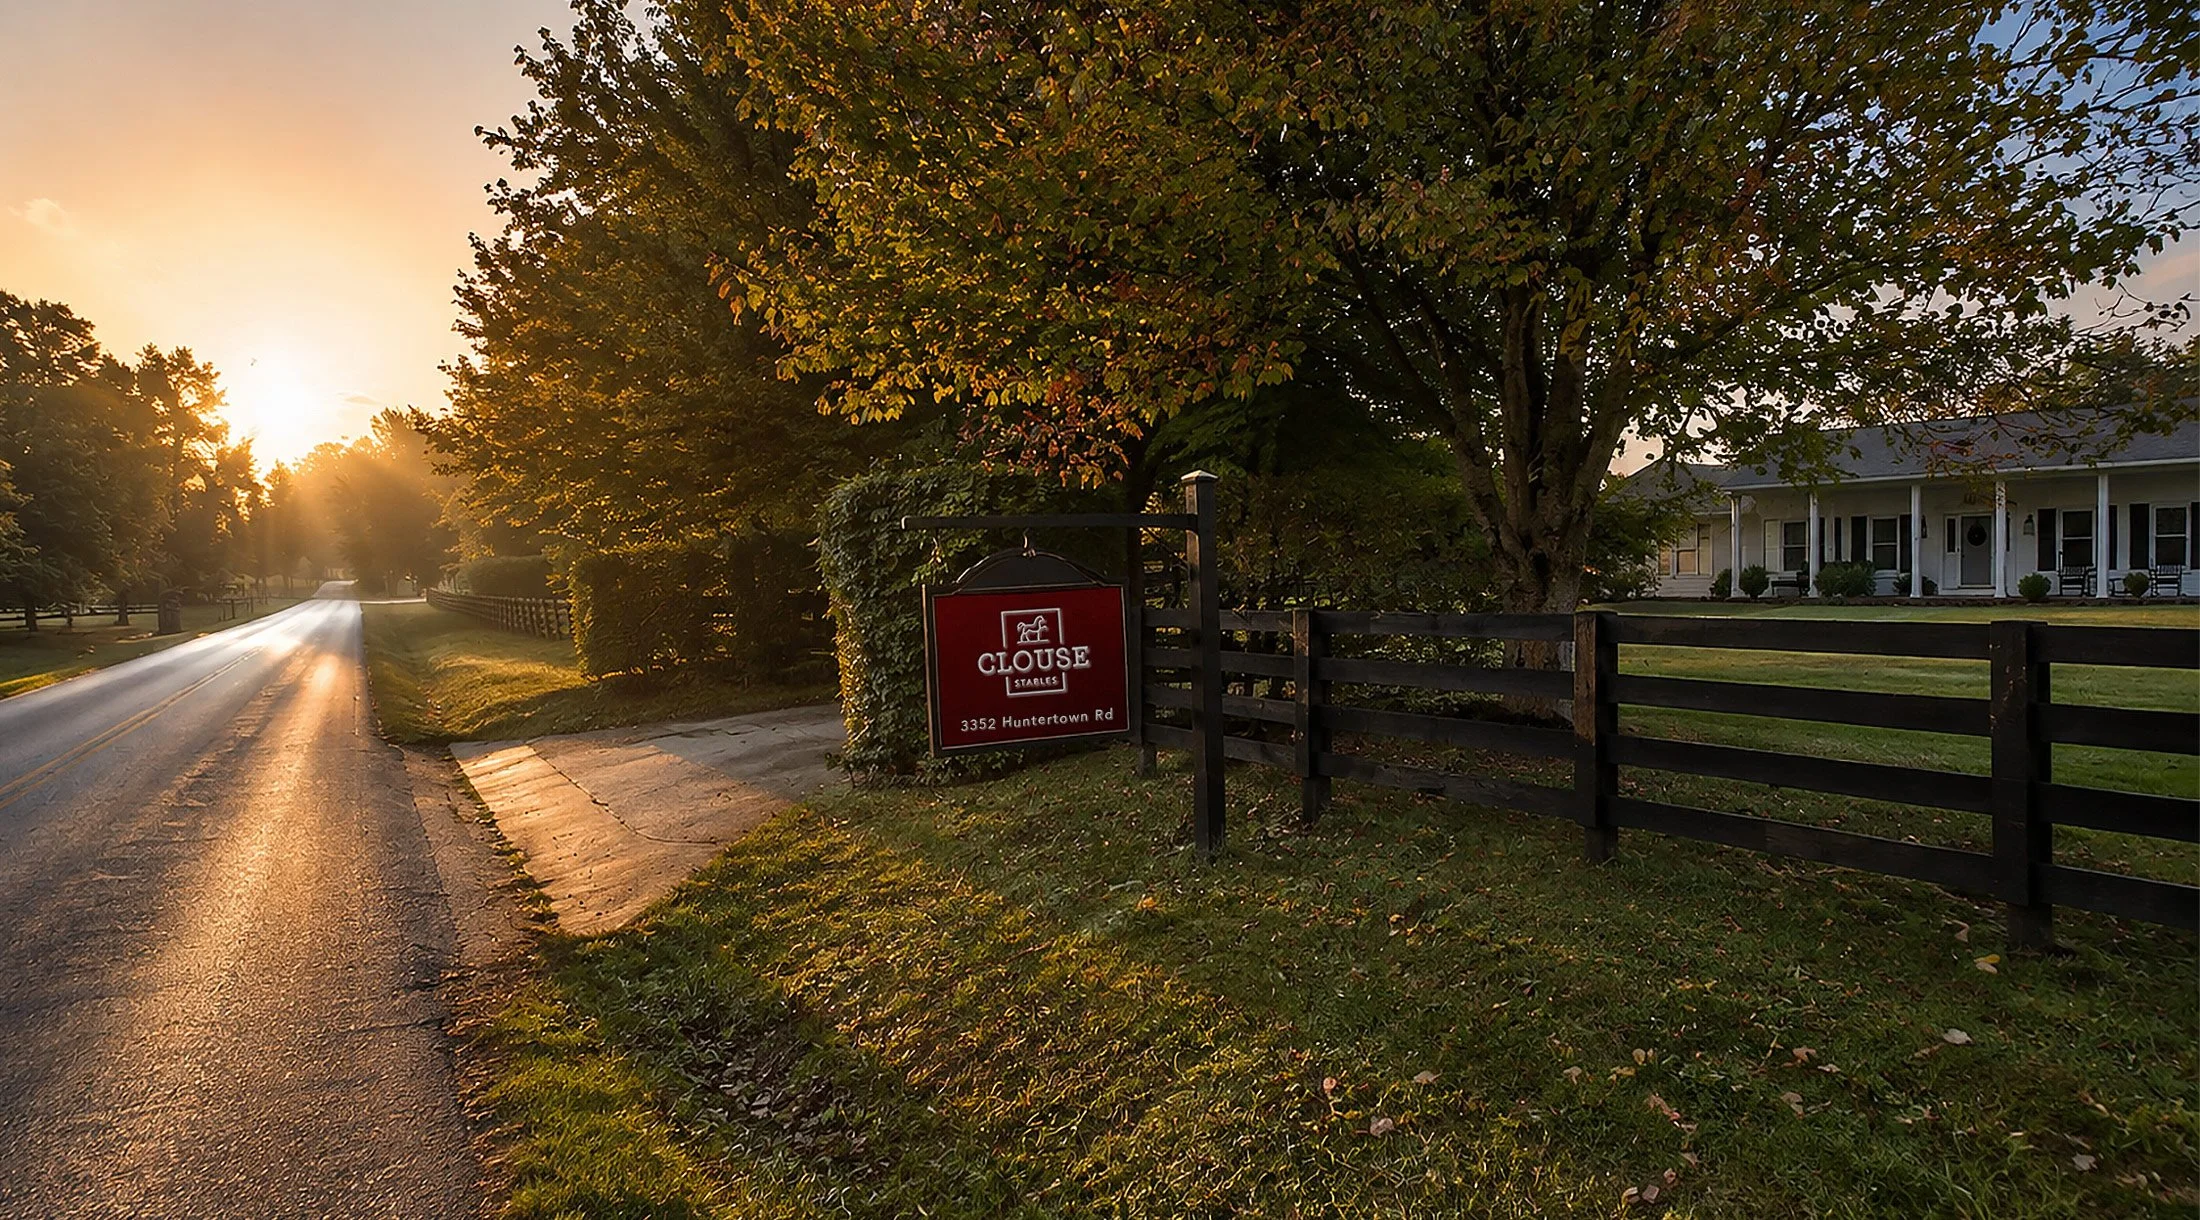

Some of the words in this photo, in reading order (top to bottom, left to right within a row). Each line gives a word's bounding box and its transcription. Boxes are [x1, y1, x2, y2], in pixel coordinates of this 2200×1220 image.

[977, 645, 1091, 675] CLOUSE
[1014, 676, 1059, 689] STABLES
[960, 718, 996, 732] 3352
[1002, 711, 1089, 728] Huntertown
[1095, 707, 1114, 721] Rd
